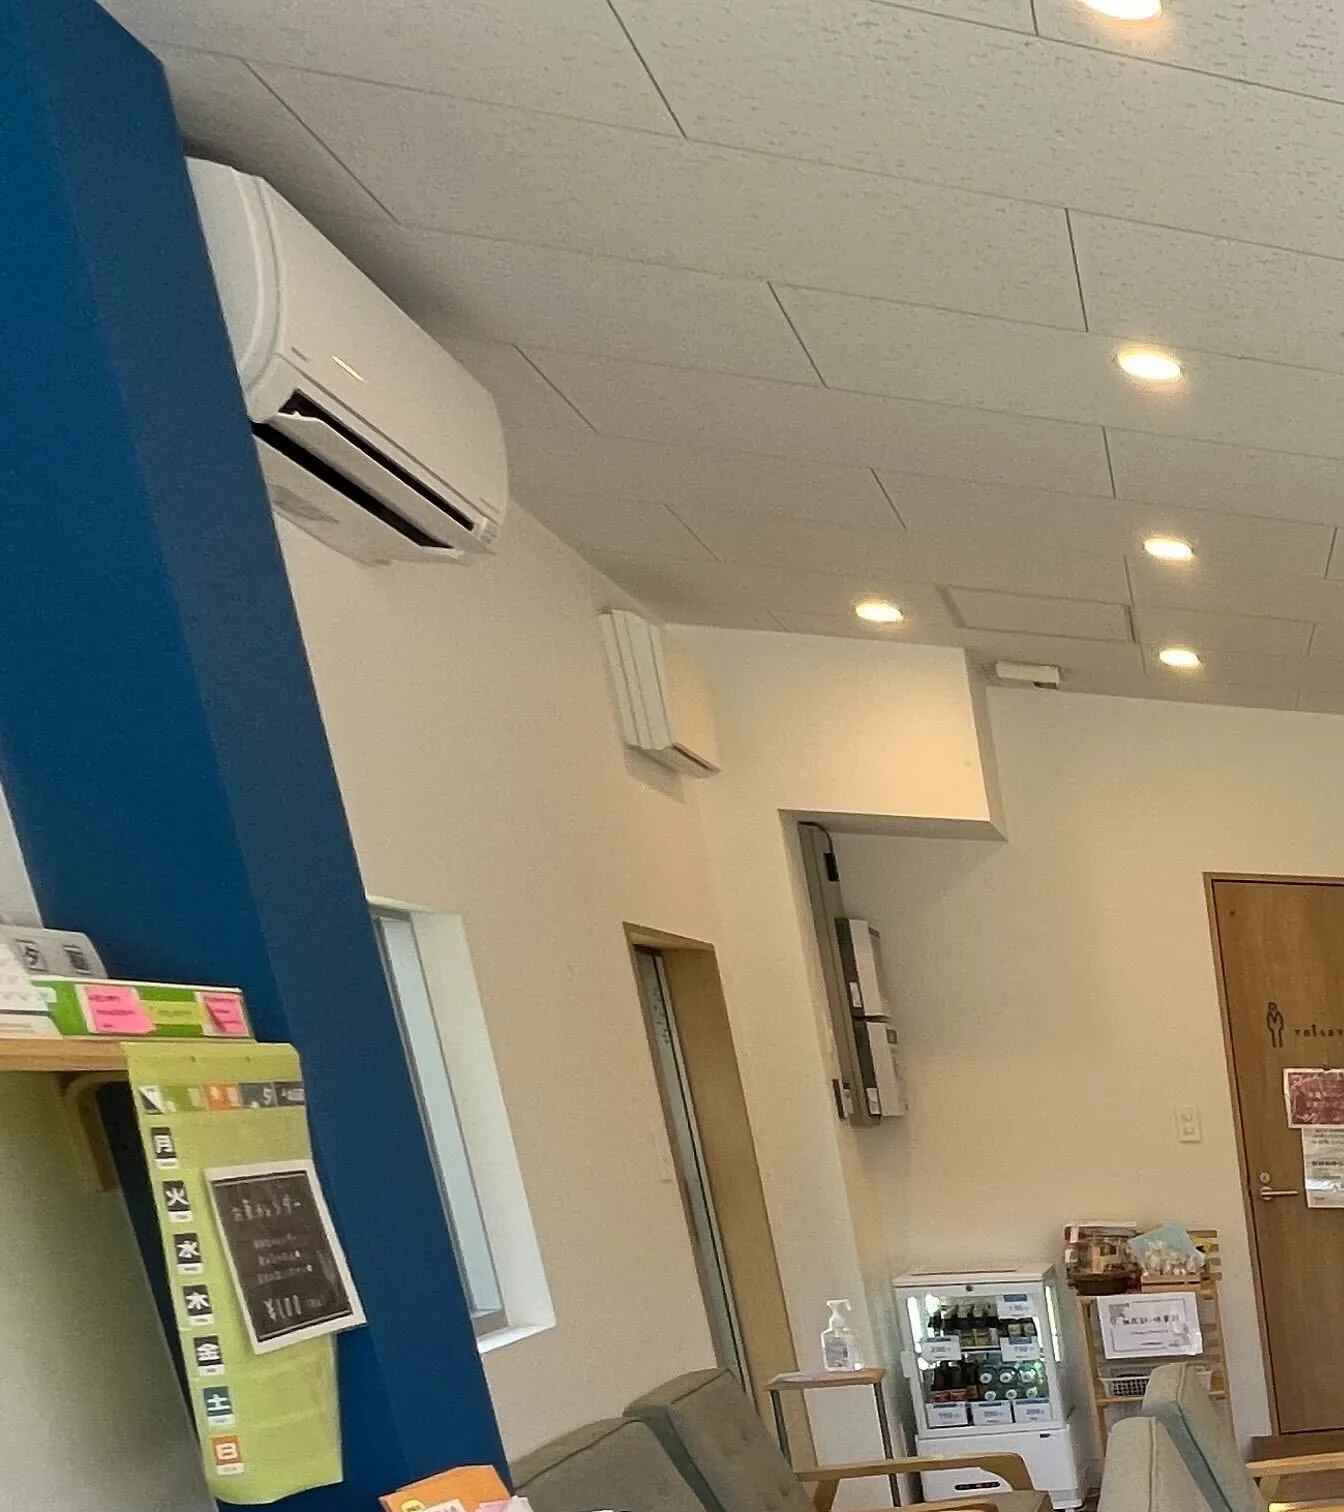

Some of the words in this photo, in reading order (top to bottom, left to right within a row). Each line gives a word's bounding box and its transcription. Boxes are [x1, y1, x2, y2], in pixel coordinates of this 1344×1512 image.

[154, 1134, 175, 1154] 月
[165, 1187, 188, 1207] 火
[178, 1240, 201, 1259] 水
[185, 1292, 209, 1311] 木
[197, 1343, 221, 1362] 金
[206, 1393, 230, 1411] 土
[215, 1441, 239, 1461] 日
